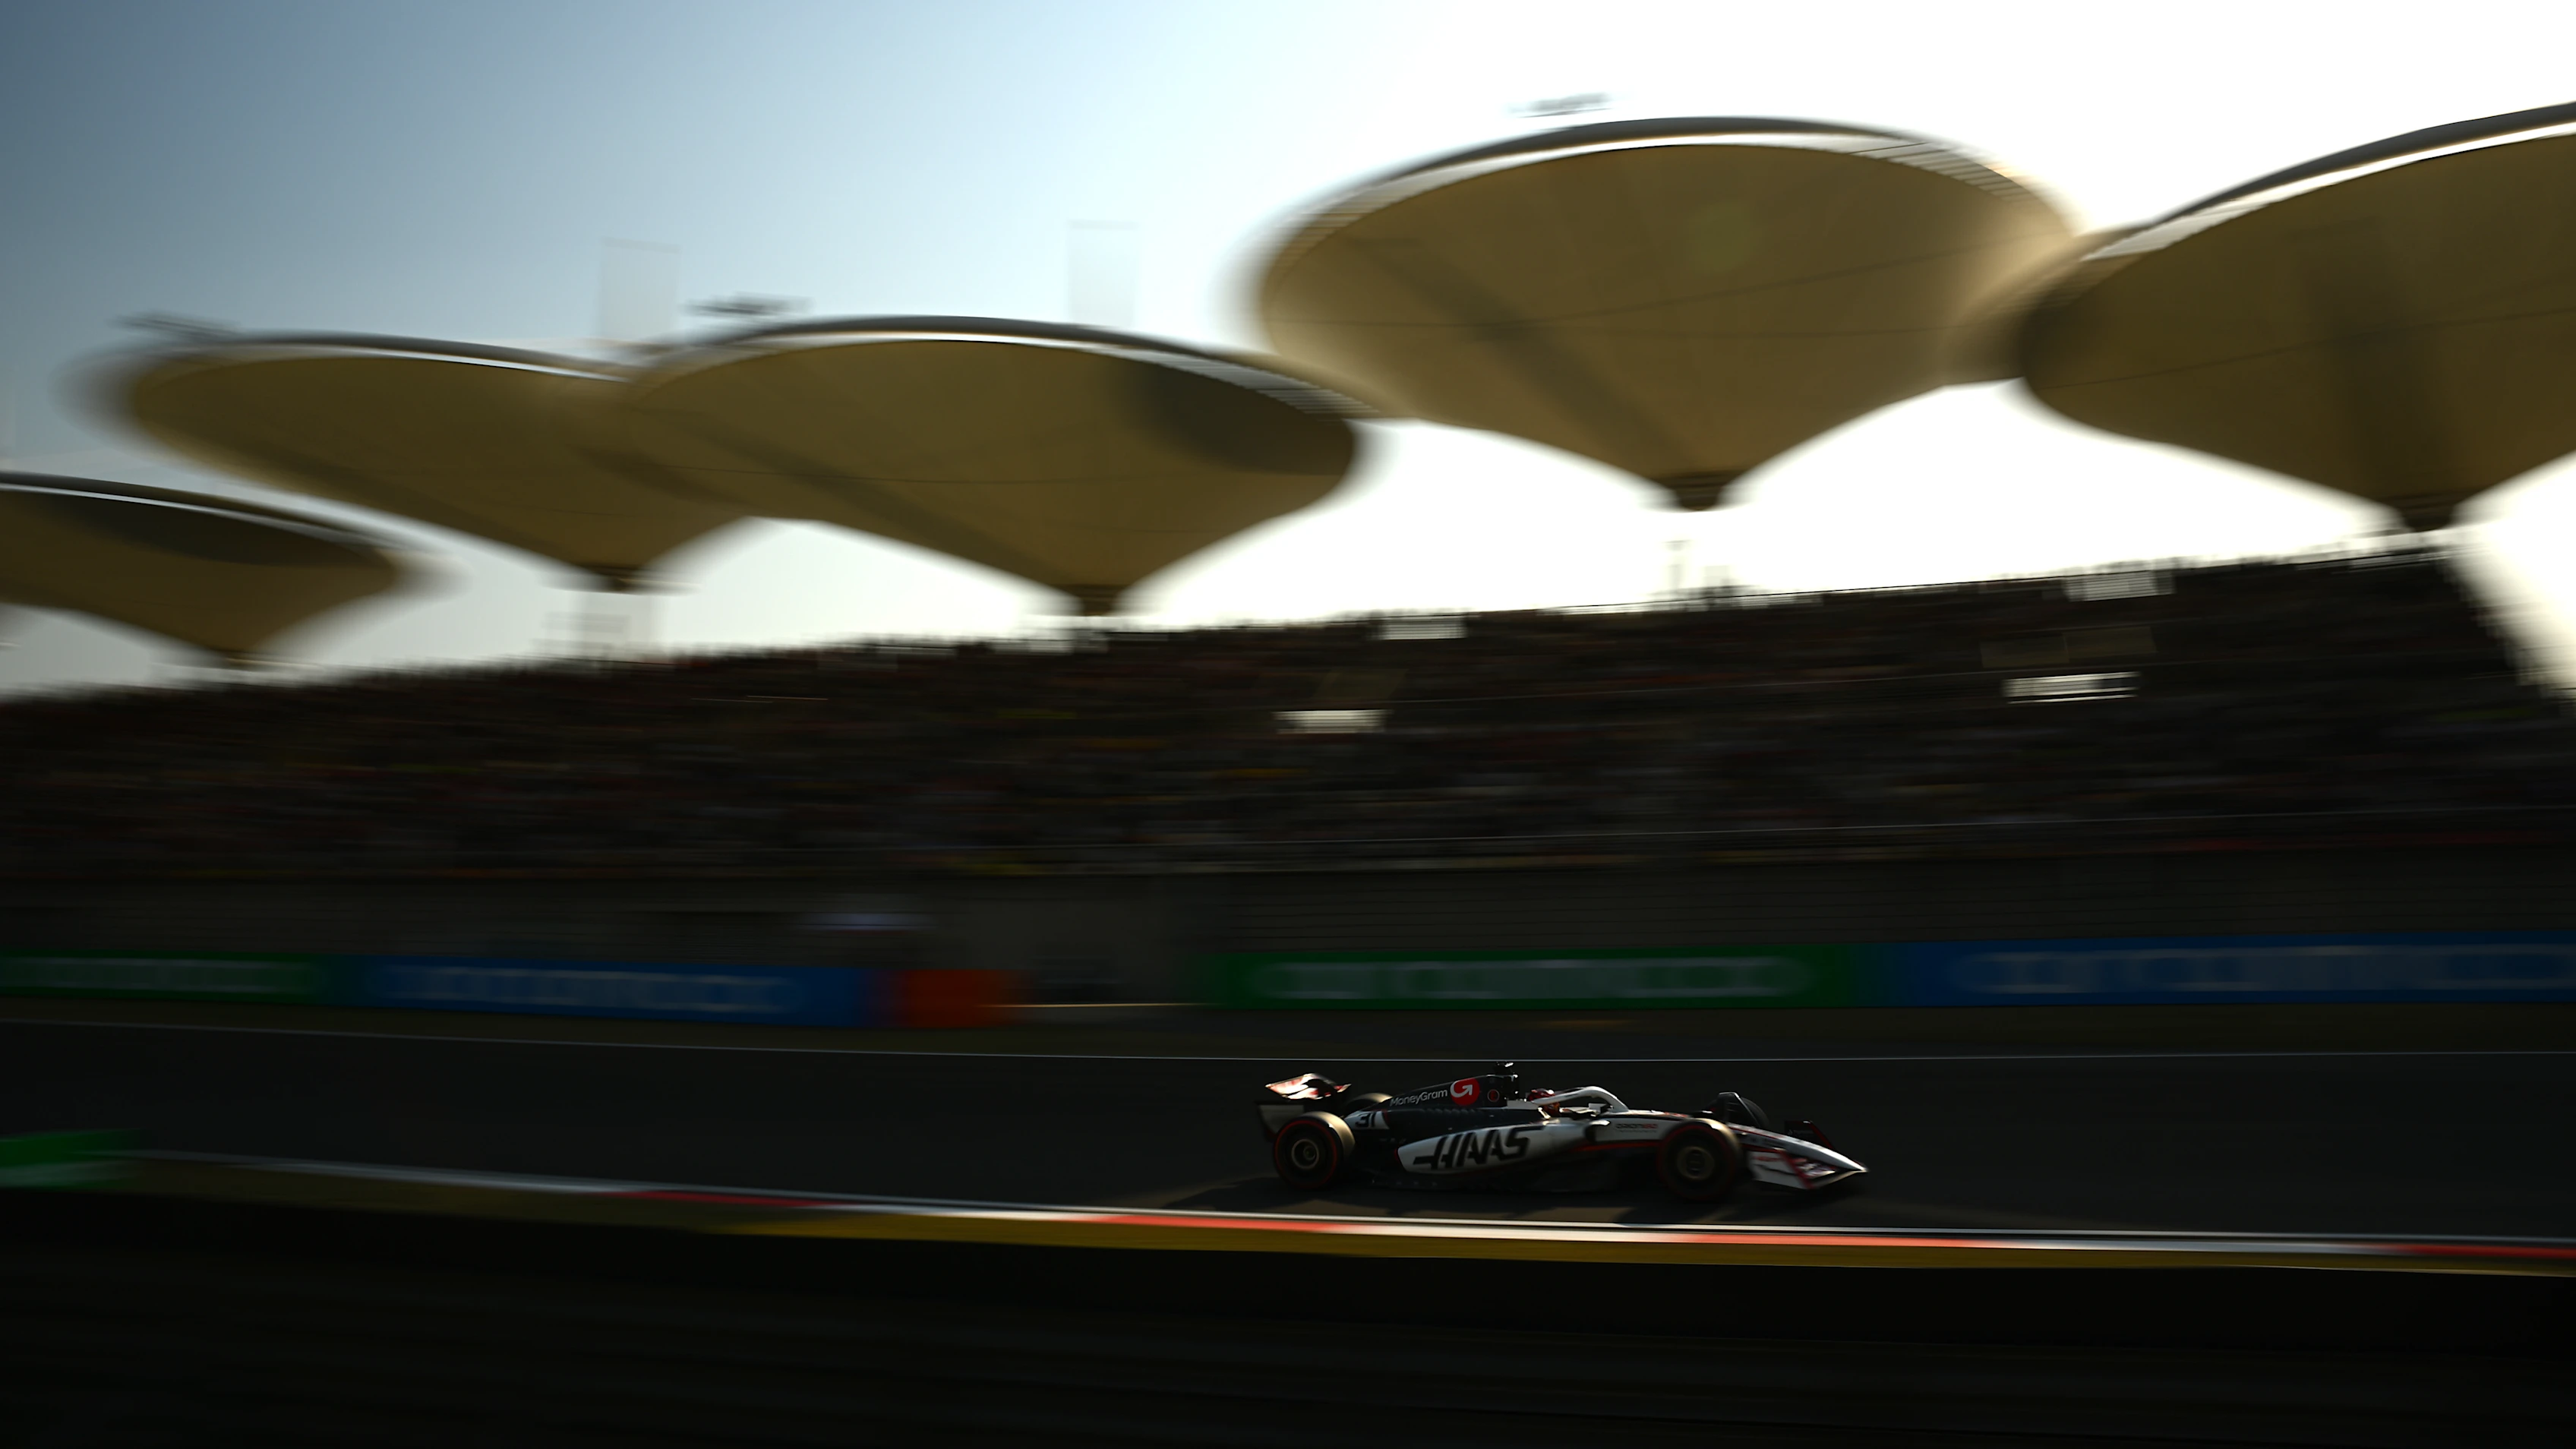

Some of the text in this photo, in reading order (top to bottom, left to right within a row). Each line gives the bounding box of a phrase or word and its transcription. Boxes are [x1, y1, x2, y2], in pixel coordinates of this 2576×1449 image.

[1390, 1089, 1448, 1106] MoneyGram
[1356, 1113, 1376, 1127] 31
[1413, 1125, 1544, 1170] HAAS
